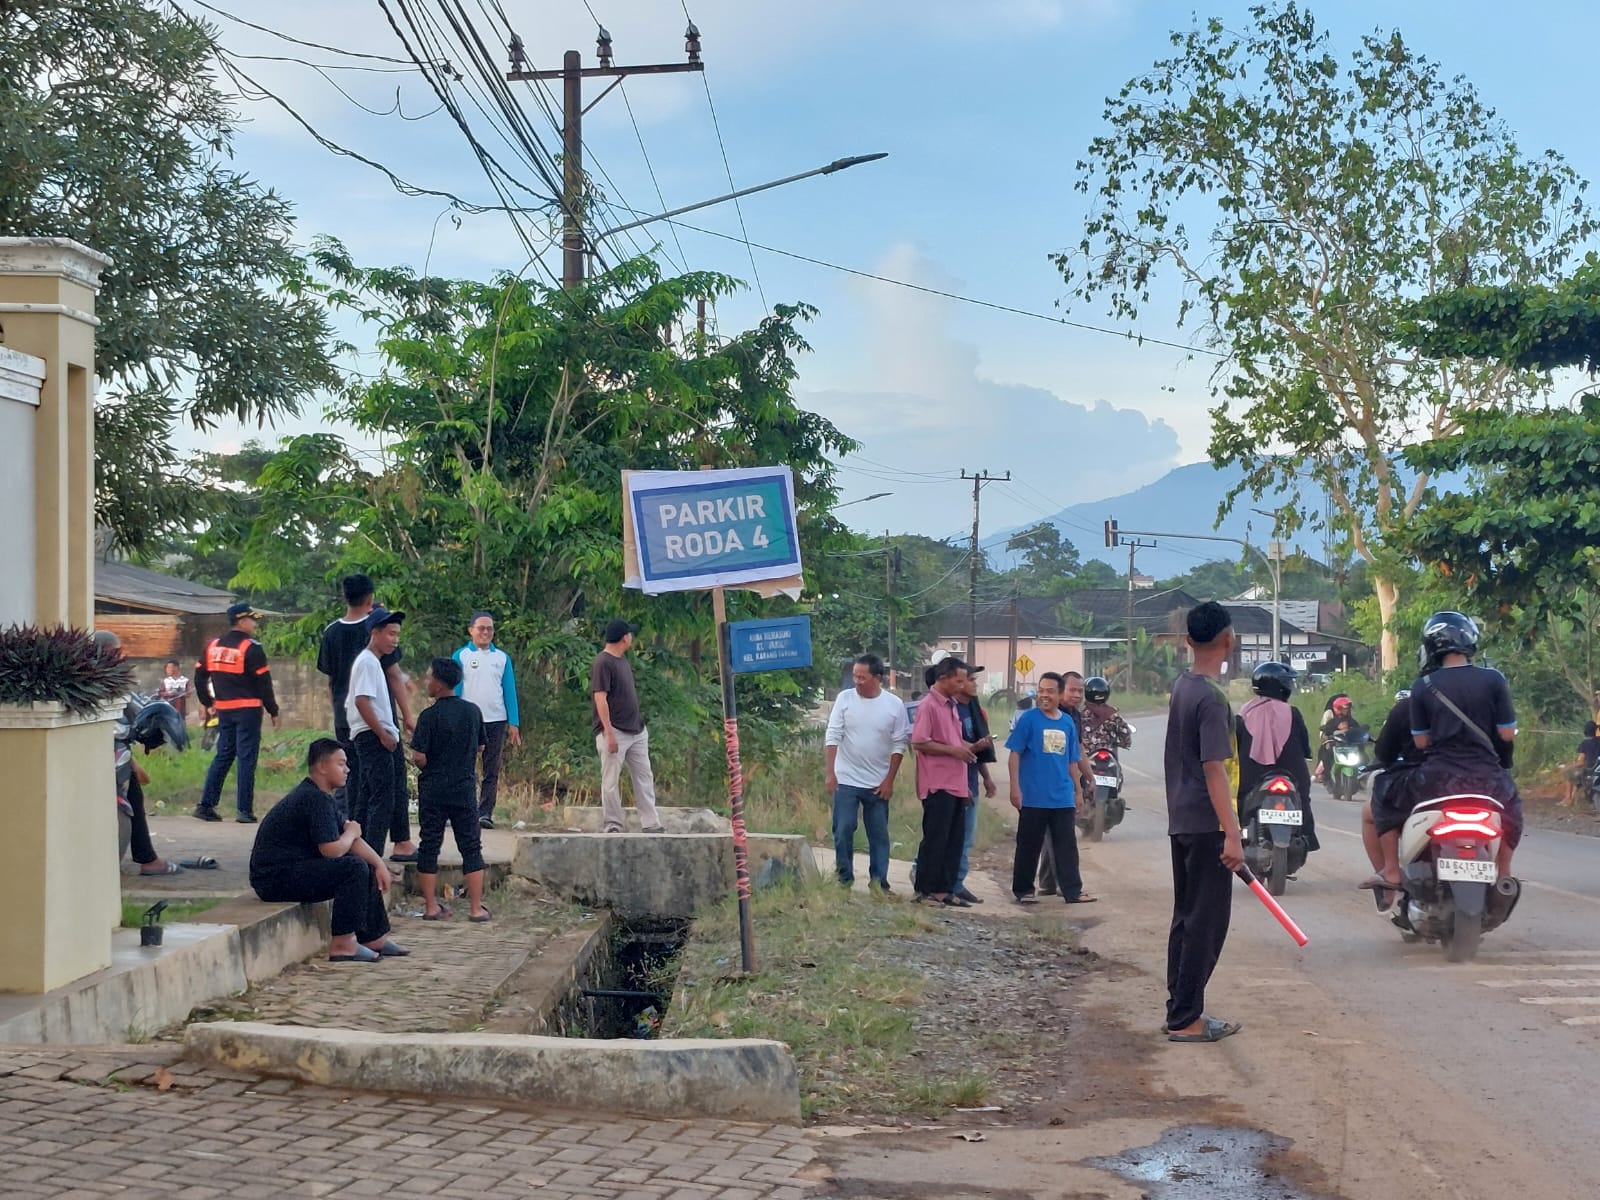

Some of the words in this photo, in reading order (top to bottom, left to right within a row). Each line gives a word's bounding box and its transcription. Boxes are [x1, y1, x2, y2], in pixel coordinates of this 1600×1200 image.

[659, 495, 766, 528] PARKIR
[665, 529, 744, 559] RODA
[753, 525, 769, 548] 4
[1291, 652, 1317, 660] KACA
[1439, 860, 1450, 869] DA
[1477, 863, 1494, 872] LBY
